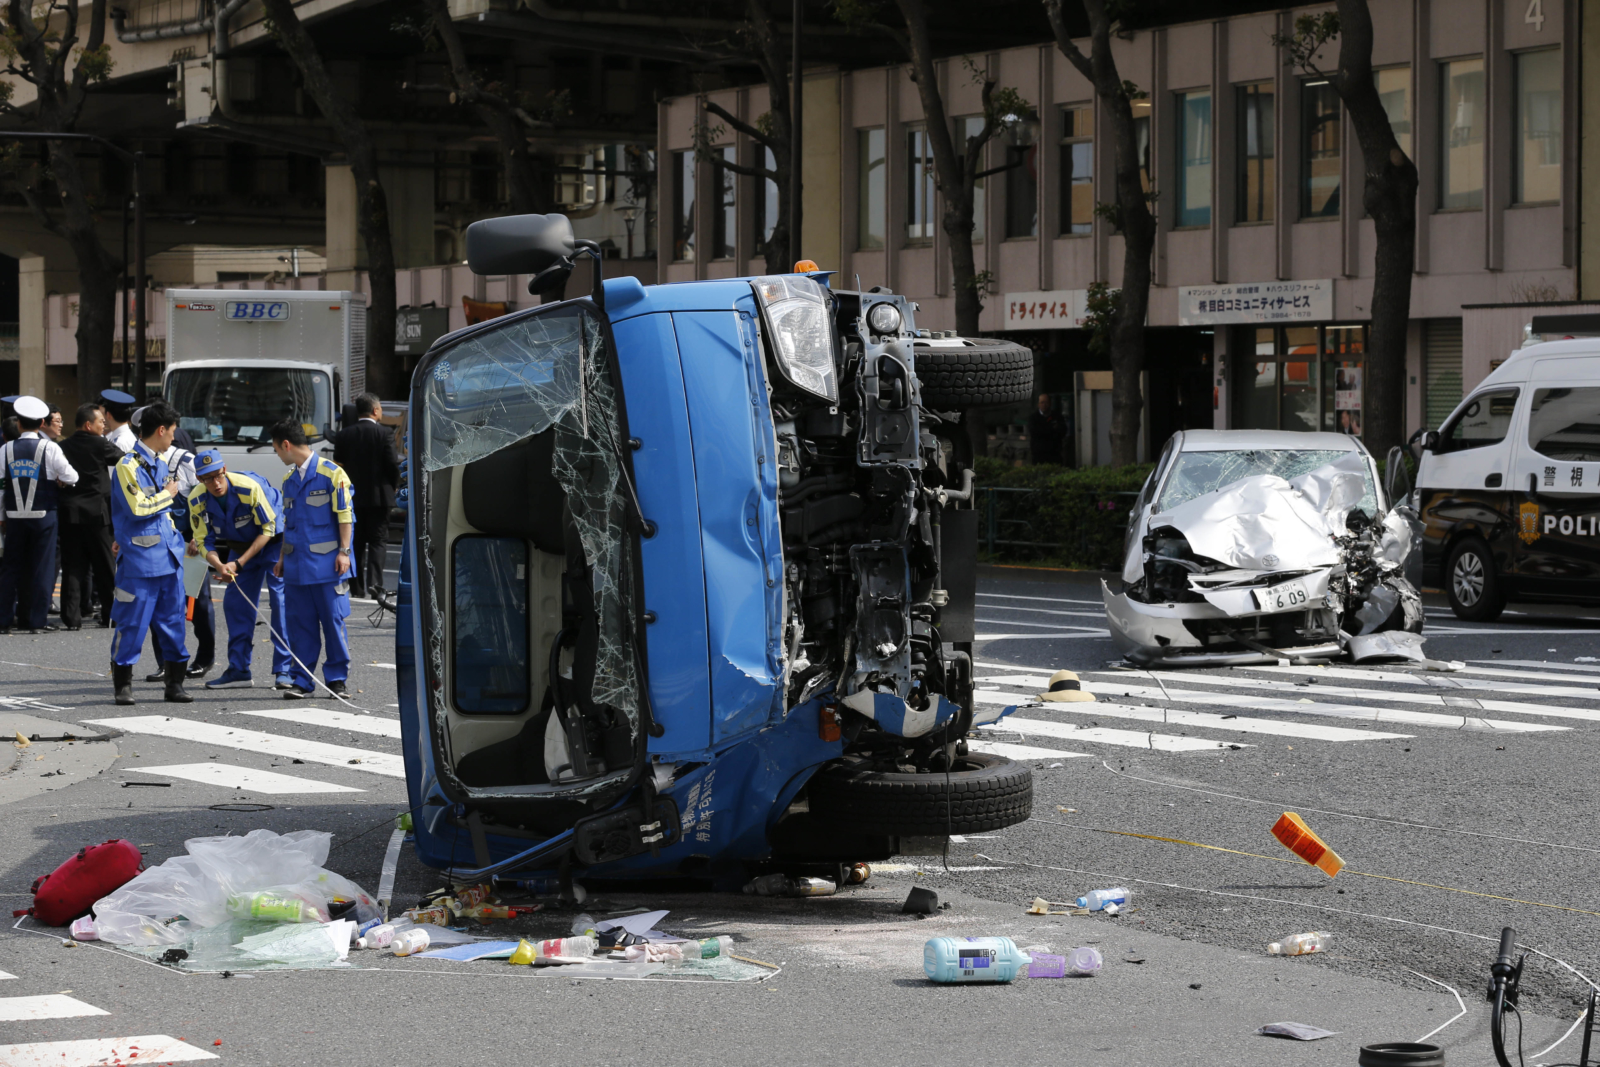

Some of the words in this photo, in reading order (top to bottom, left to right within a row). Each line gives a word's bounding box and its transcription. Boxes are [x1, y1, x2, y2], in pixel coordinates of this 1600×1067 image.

[1524, 0, 1545, 32] 4
[1192, 288, 1217, 296] マンション
[1221, 287, 1232, 295] ビル
[1271, 283, 1321, 293] ハウスリフォーム
[232, 303, 282, 318] BBC
[1010, 301, 1068, 320] ドライアイス
[406, 324, 422, 338] SUN
[10, 460, 39, 470] POLICE
[1543, 466, 1600, 488] 警視
[1543, 515, 1600, 536] POLI
